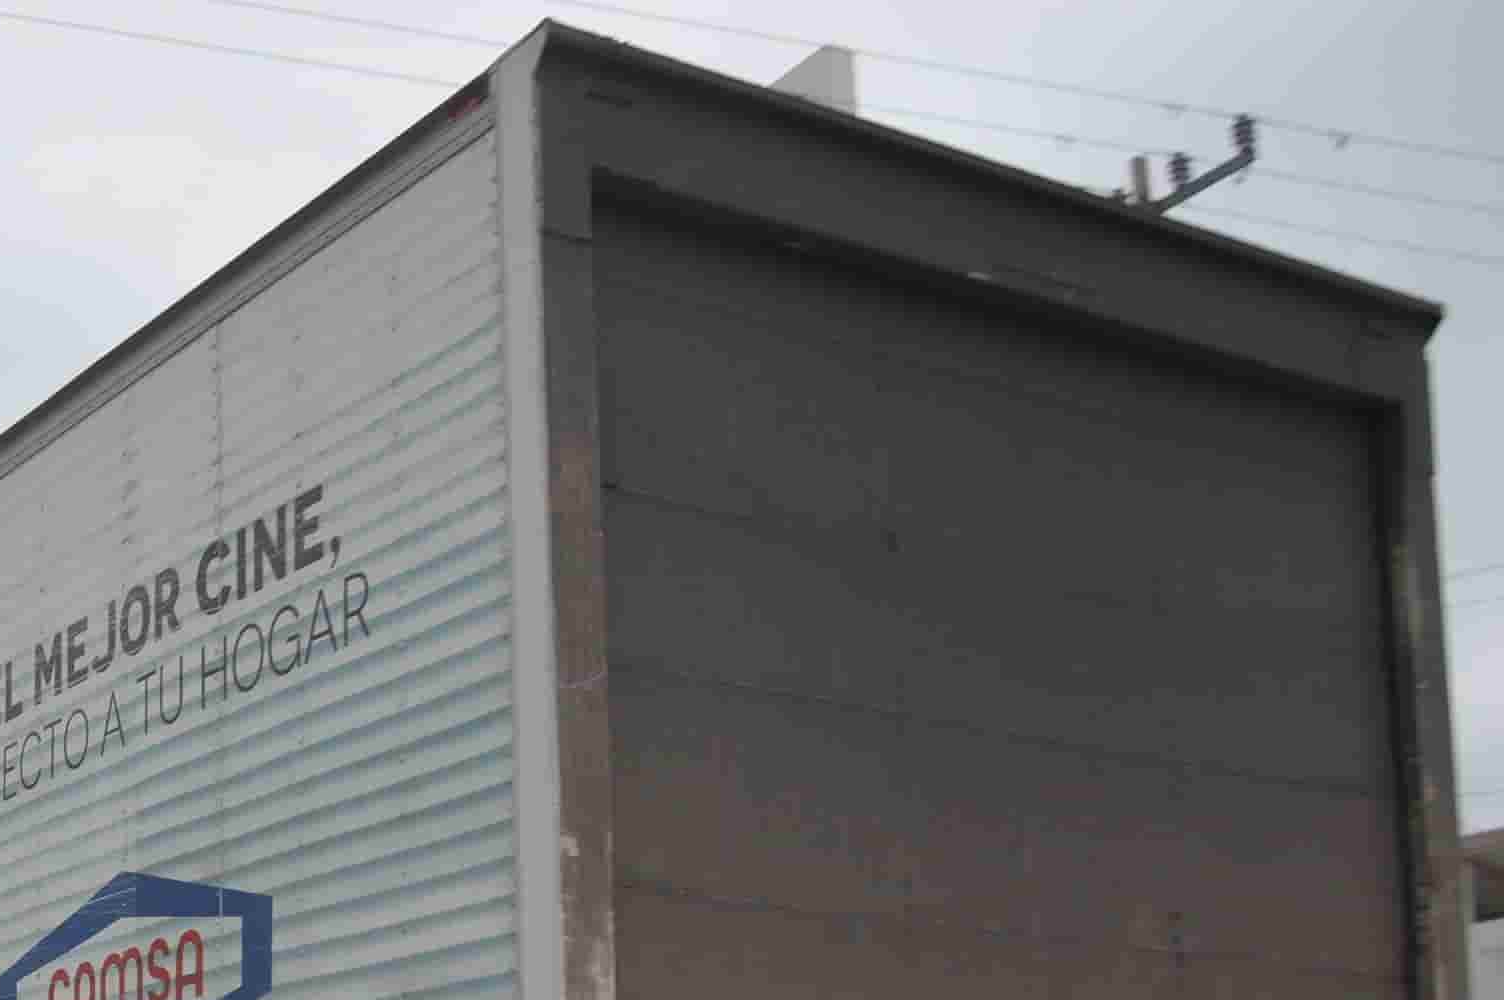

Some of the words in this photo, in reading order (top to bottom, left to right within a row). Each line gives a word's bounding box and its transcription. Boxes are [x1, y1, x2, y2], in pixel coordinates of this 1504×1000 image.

[34, 568, 182, 706] MEJOR
[197, 484, 342, 616] CINE,
[99, 690, 127, 757] A
[136, 655, 185, 735] TU
[201, 571, 374, 710] HOGAR
